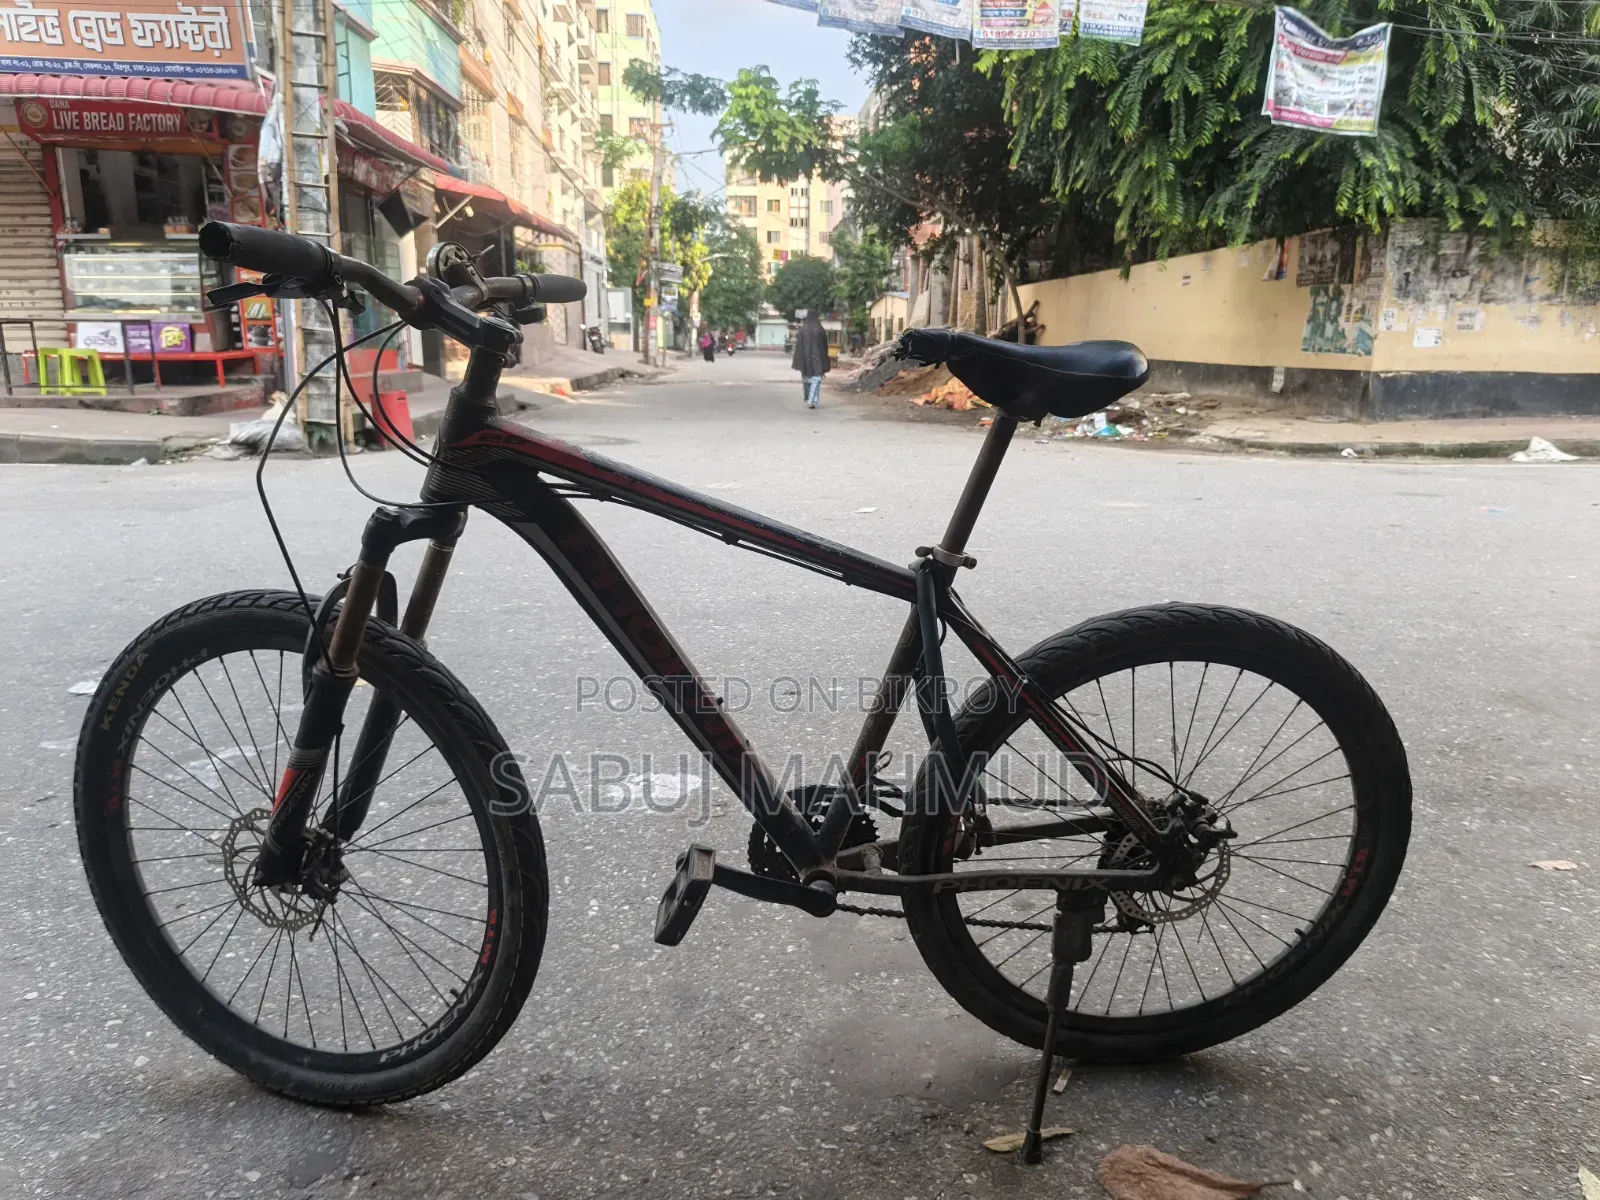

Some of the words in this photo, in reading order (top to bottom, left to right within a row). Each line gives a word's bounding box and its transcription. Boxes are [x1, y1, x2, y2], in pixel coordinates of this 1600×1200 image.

[68, 10, 124, 52] ব্রেড
[127, 1, 232, 57] ফ্যাক্টরী
[52, 110, 80, 130] LIVE
[83, 111, 124, 131] BREAD
[129, 112, 181, 133] FACTORY
[100, 650, 150, 731] KENDA
[117, 647, 208, 753] PHOENIX
[932, 874, 1110, 895] PHOENIX
[379, 966, 484, 1063] PHOENIX
